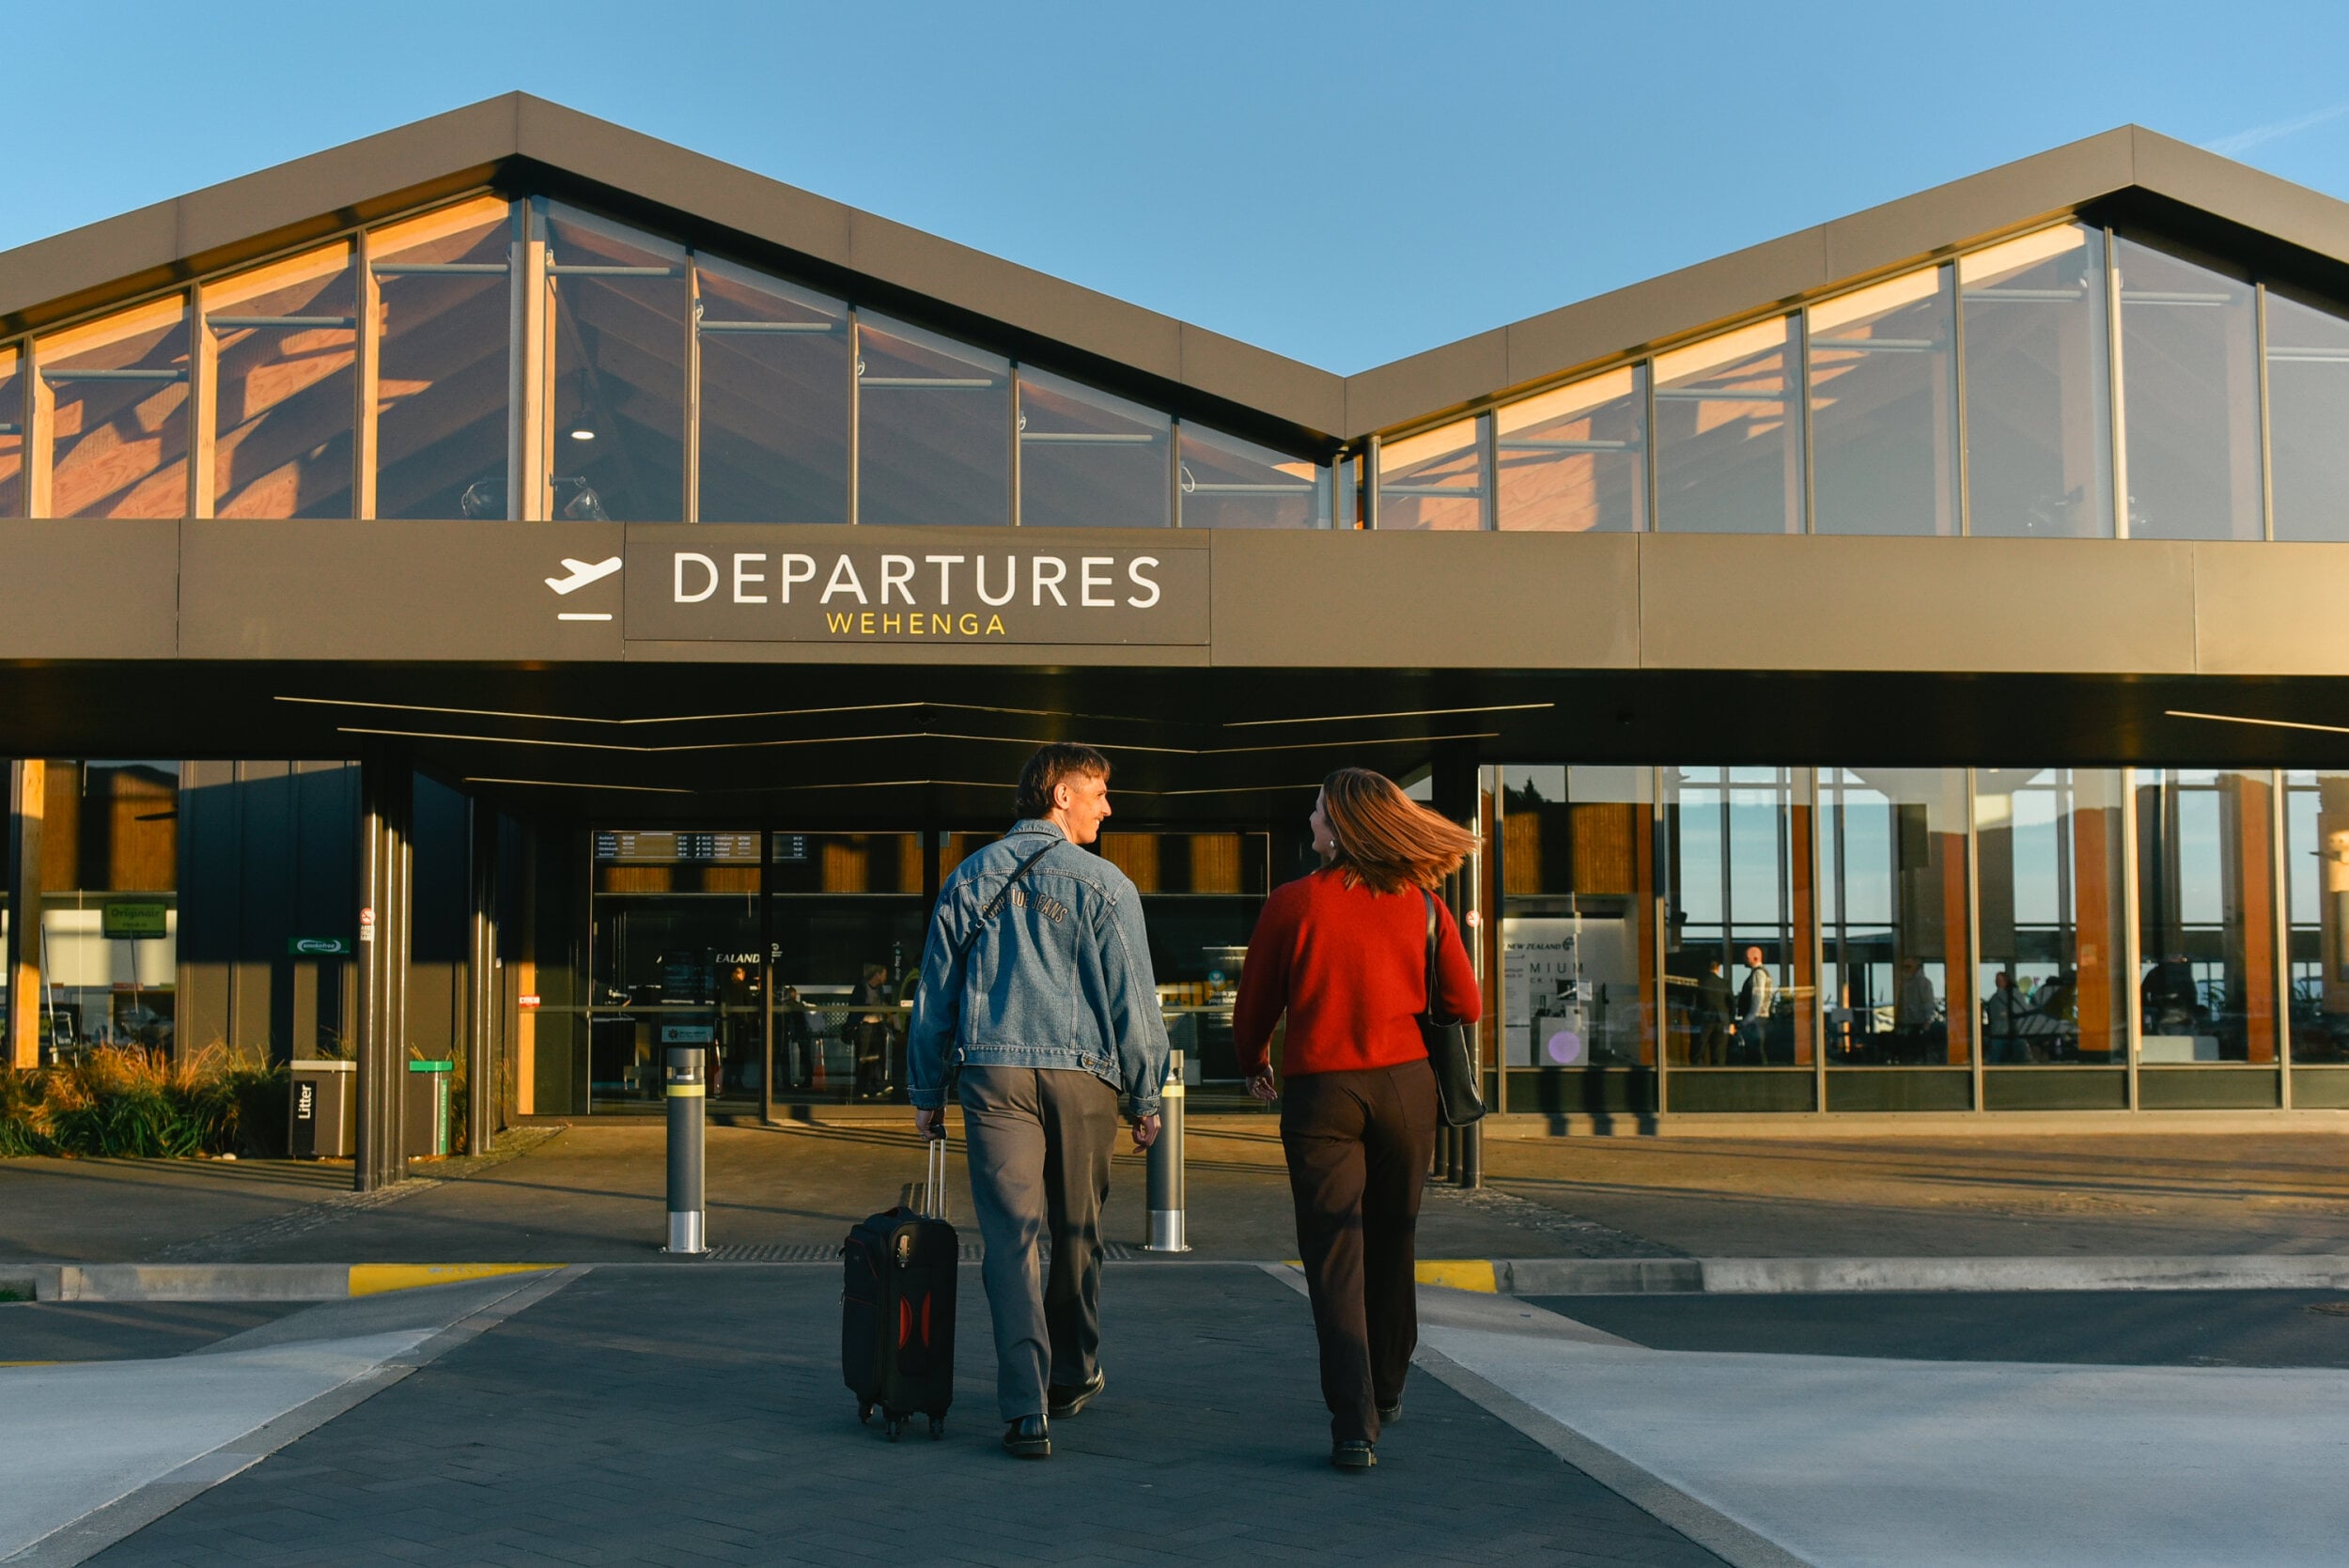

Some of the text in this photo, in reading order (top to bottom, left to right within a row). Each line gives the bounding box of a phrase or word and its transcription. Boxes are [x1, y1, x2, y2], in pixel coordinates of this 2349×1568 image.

[673, 551, 1162, 610] DEPARTURES
[826, 612, 1005, 636] WEHENGA
[112, 907, 160, 920] Originair
[1005, 888, 1031, 908] BLUE
[1032, 893, 1068, 924] JEANS
[715, 953, 760, 964] EALAND
[1530, 963, 1584, 973] MIUM
[298, 1083, 312, 1119] Litter
